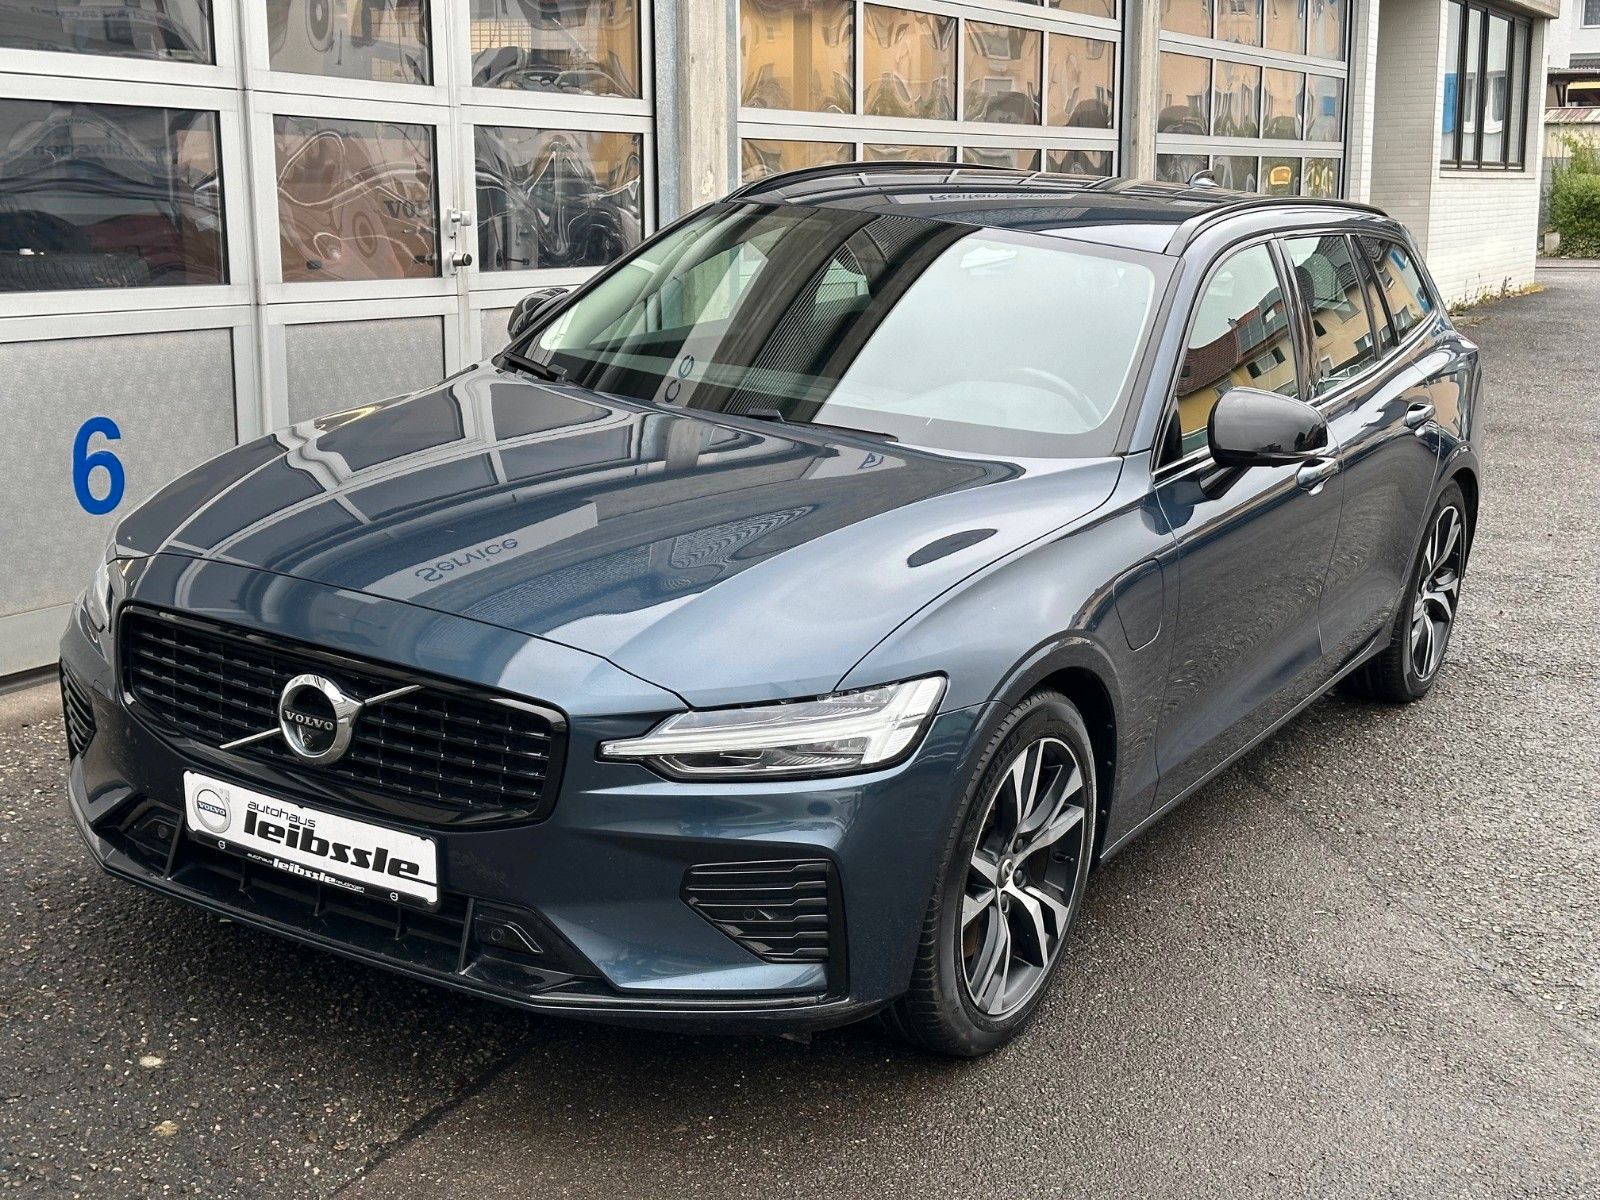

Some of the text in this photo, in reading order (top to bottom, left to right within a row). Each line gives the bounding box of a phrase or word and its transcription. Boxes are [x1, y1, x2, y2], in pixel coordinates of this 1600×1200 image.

[72, 416, 125, 515] 6
[284, 709, 334, 731] VOLVO
[197, 801, 226, 815] VOLVO
[247, 801, 316, 828] autohaus
[244, 809, 420, 877] leibssle
[273, 858, 335, 884] leibssle
